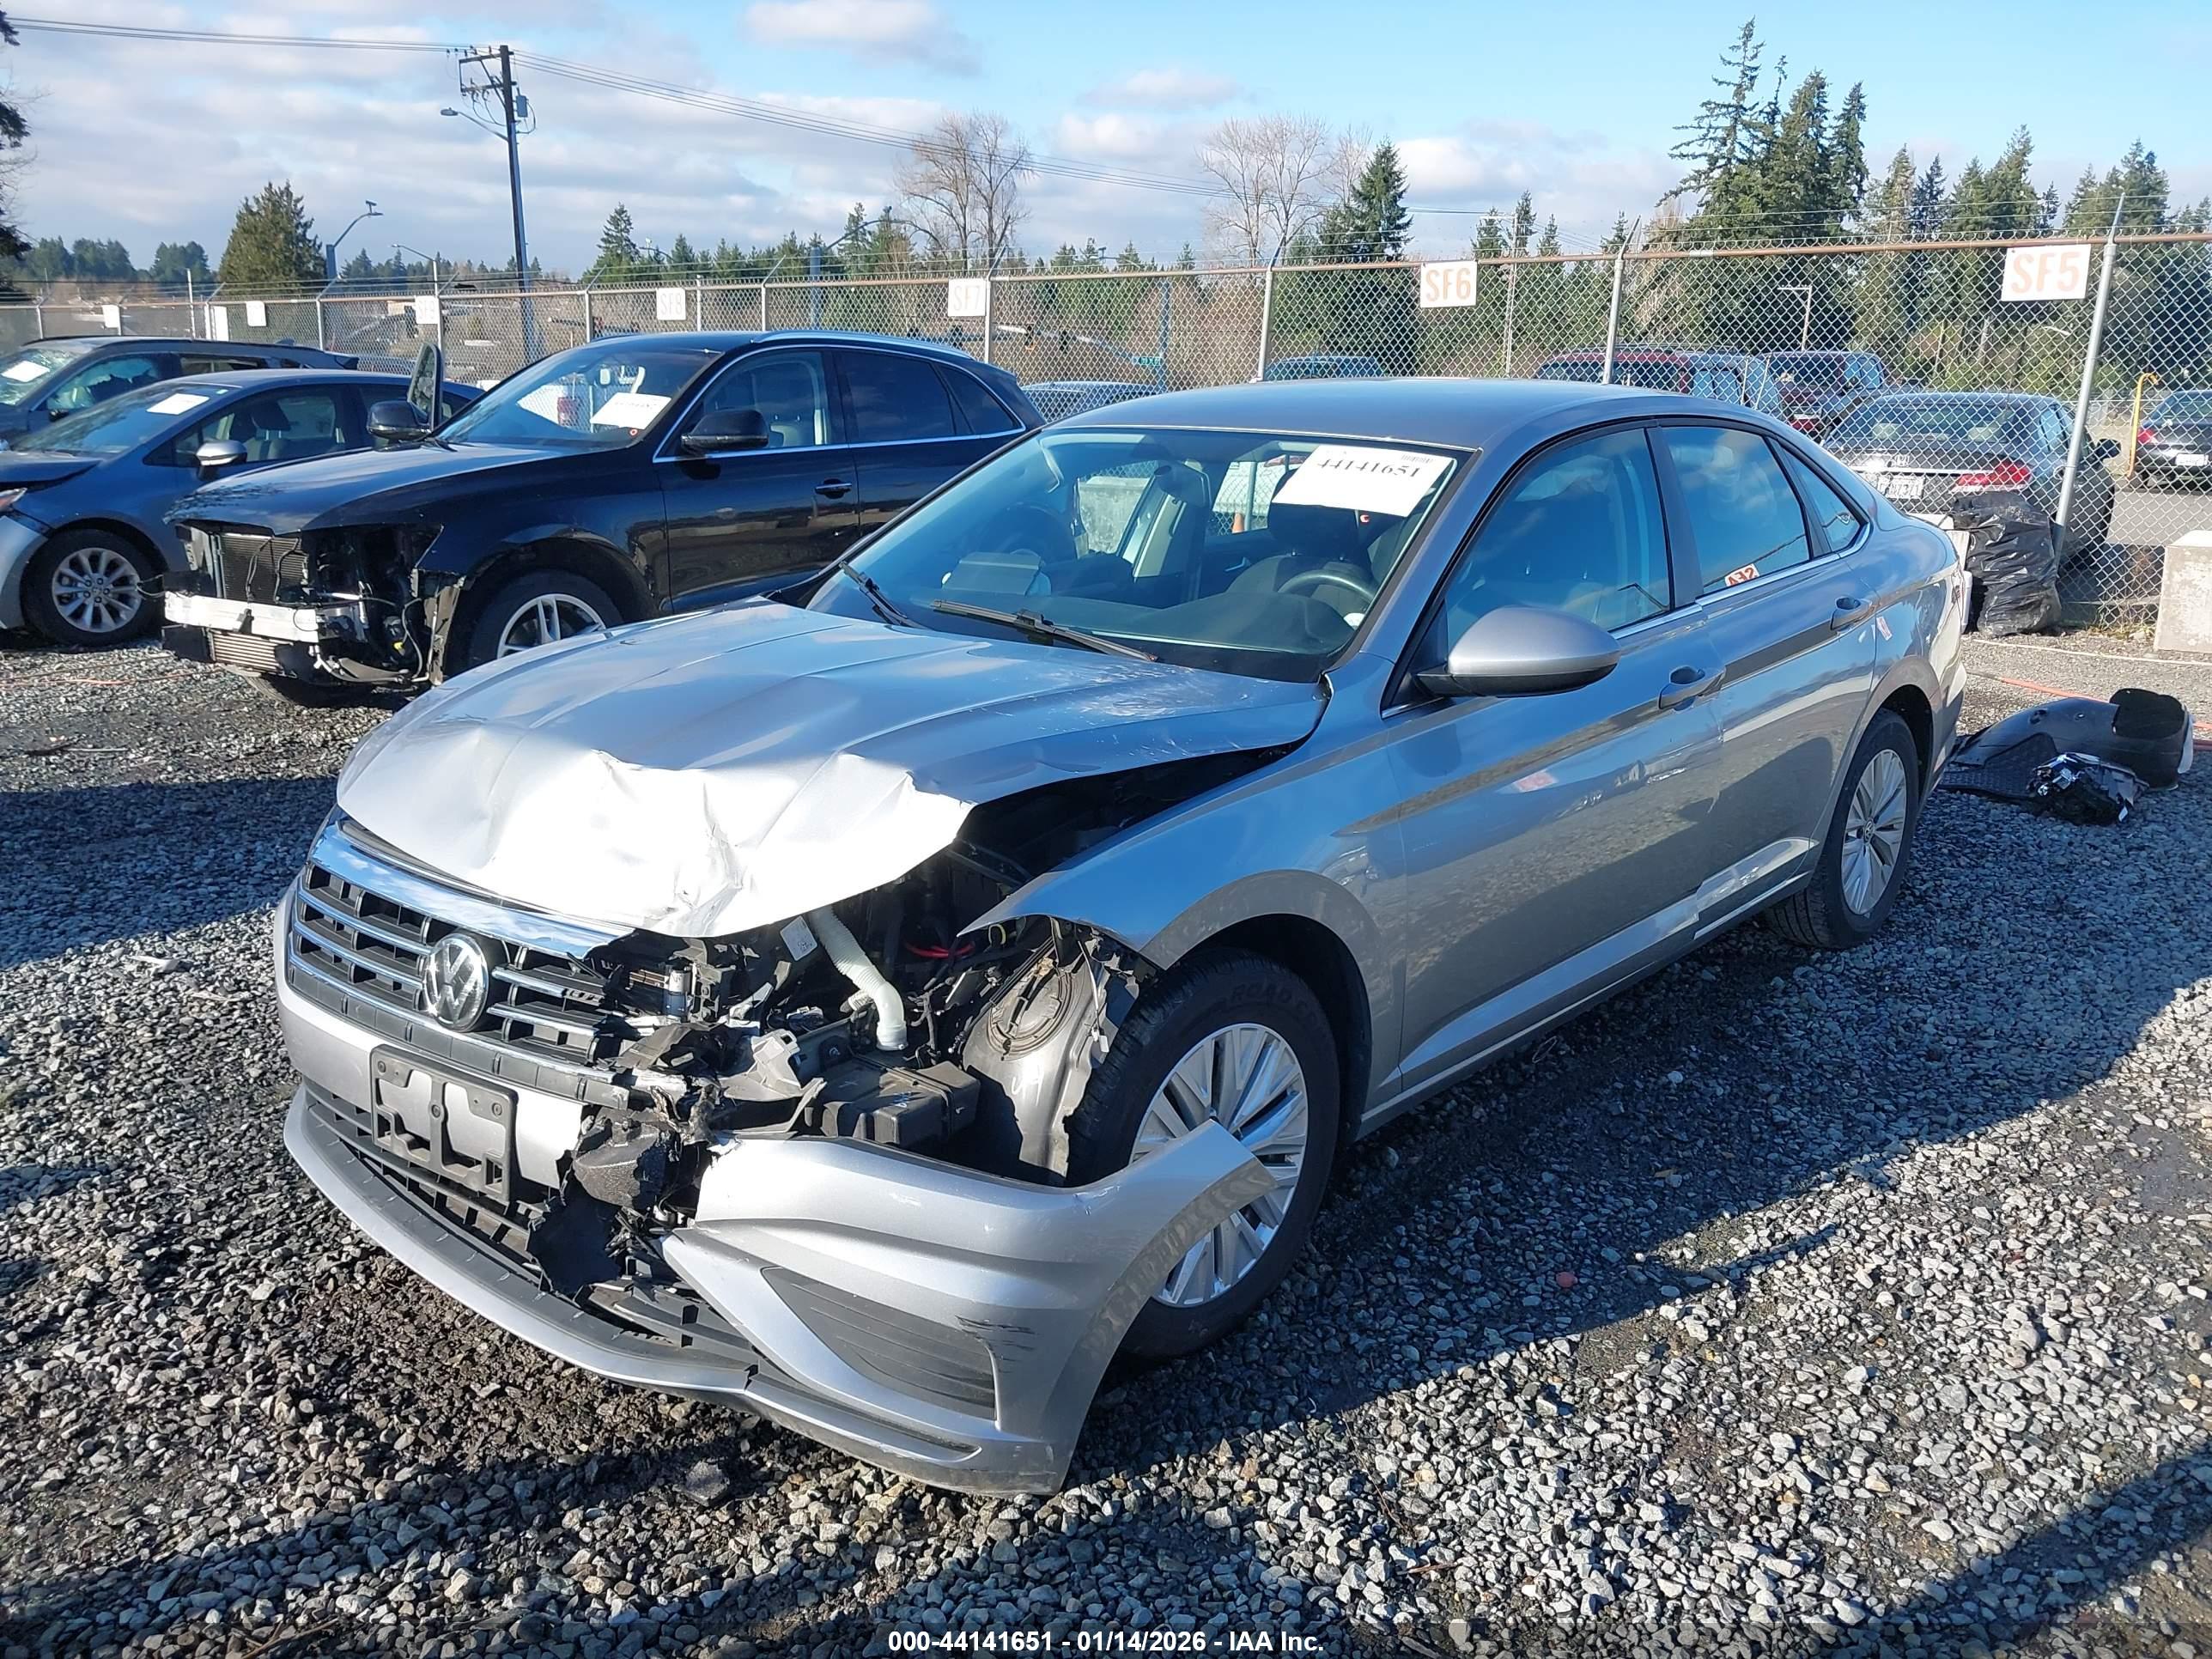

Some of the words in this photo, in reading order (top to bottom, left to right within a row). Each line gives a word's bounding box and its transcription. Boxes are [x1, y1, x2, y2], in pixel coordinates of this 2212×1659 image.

[1425, 267, 1471, 302] SF6
[2010, 252, 2081, 294] SF5
[659, 292, 683, 315] SF8
[953, 285, 981, 311] SF7
[1316, 458, 1421, 477] 44141651
